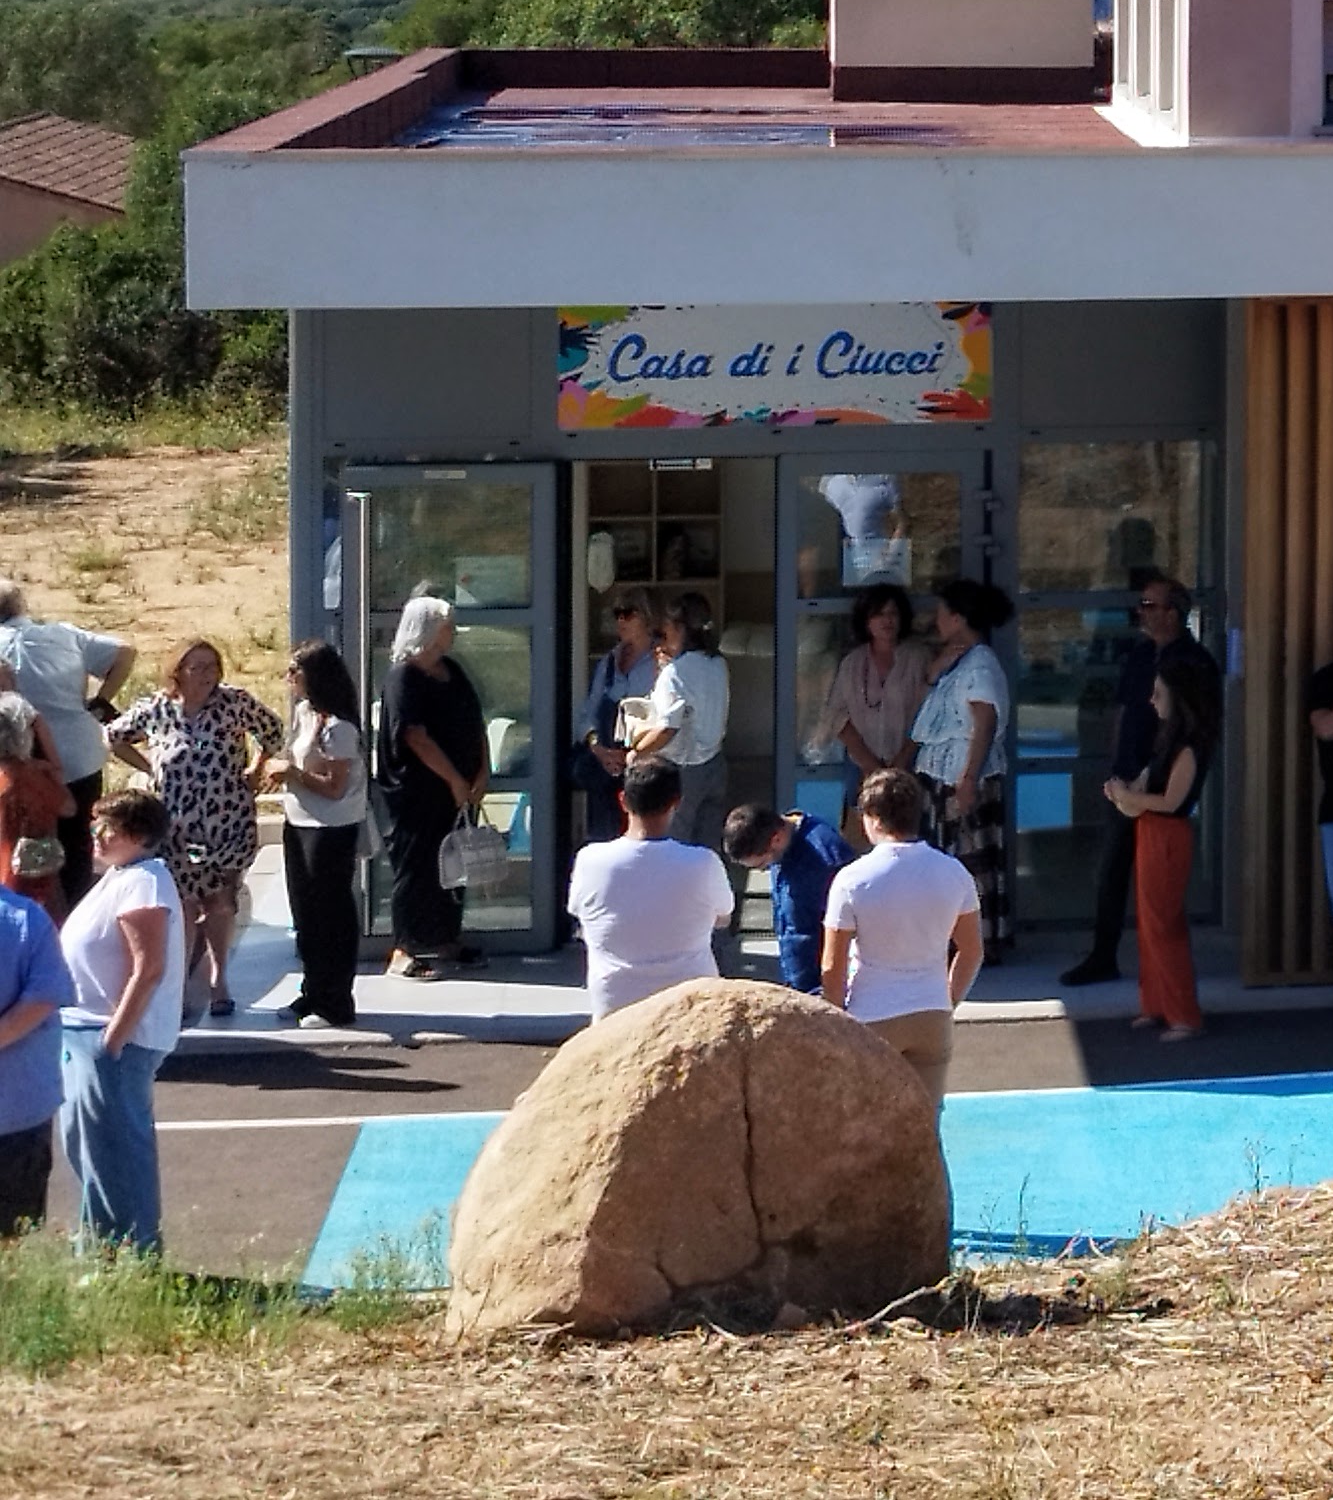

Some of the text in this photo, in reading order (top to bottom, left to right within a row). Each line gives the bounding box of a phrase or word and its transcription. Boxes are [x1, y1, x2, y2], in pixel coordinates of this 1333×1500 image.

[608, 329, 945, 382] Casa di i Ciucci
